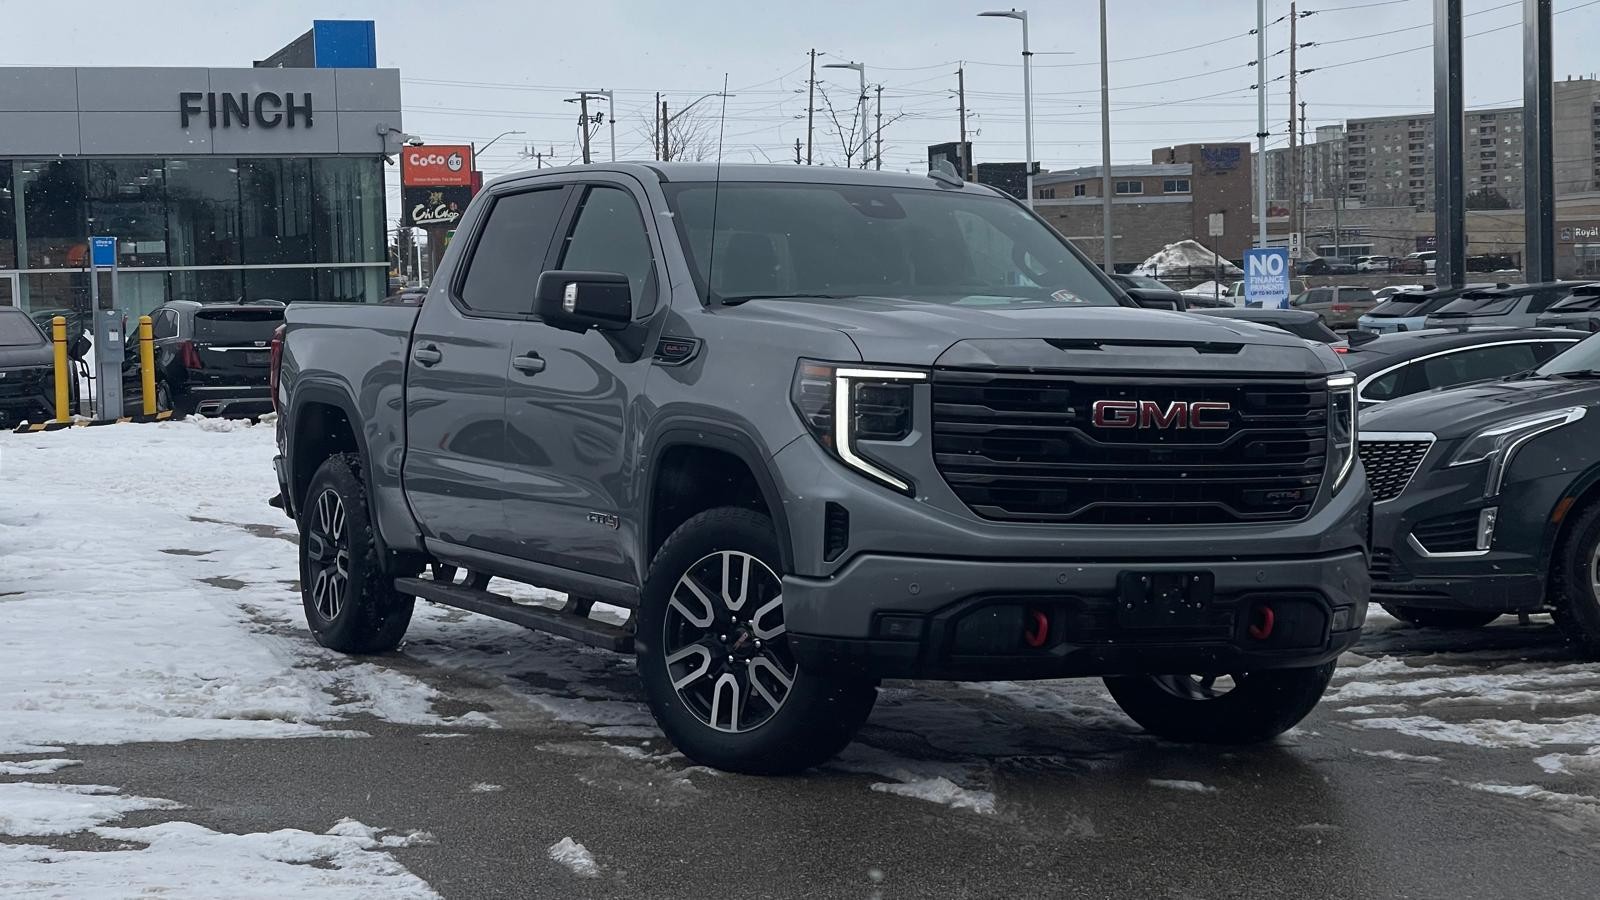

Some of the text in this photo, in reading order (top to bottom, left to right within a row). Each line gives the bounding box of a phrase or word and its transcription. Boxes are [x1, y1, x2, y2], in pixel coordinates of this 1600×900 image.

[180, 92, 313, 129] FINCH
[410, 153, 445, 167] CoCo
[1575, 227, 1599, 238] Royal
[1249, 253, 1284, 276] NO
[1250, 275, 1284, 285] FINANCE
[1092, 400, 1230, 430] GMC
